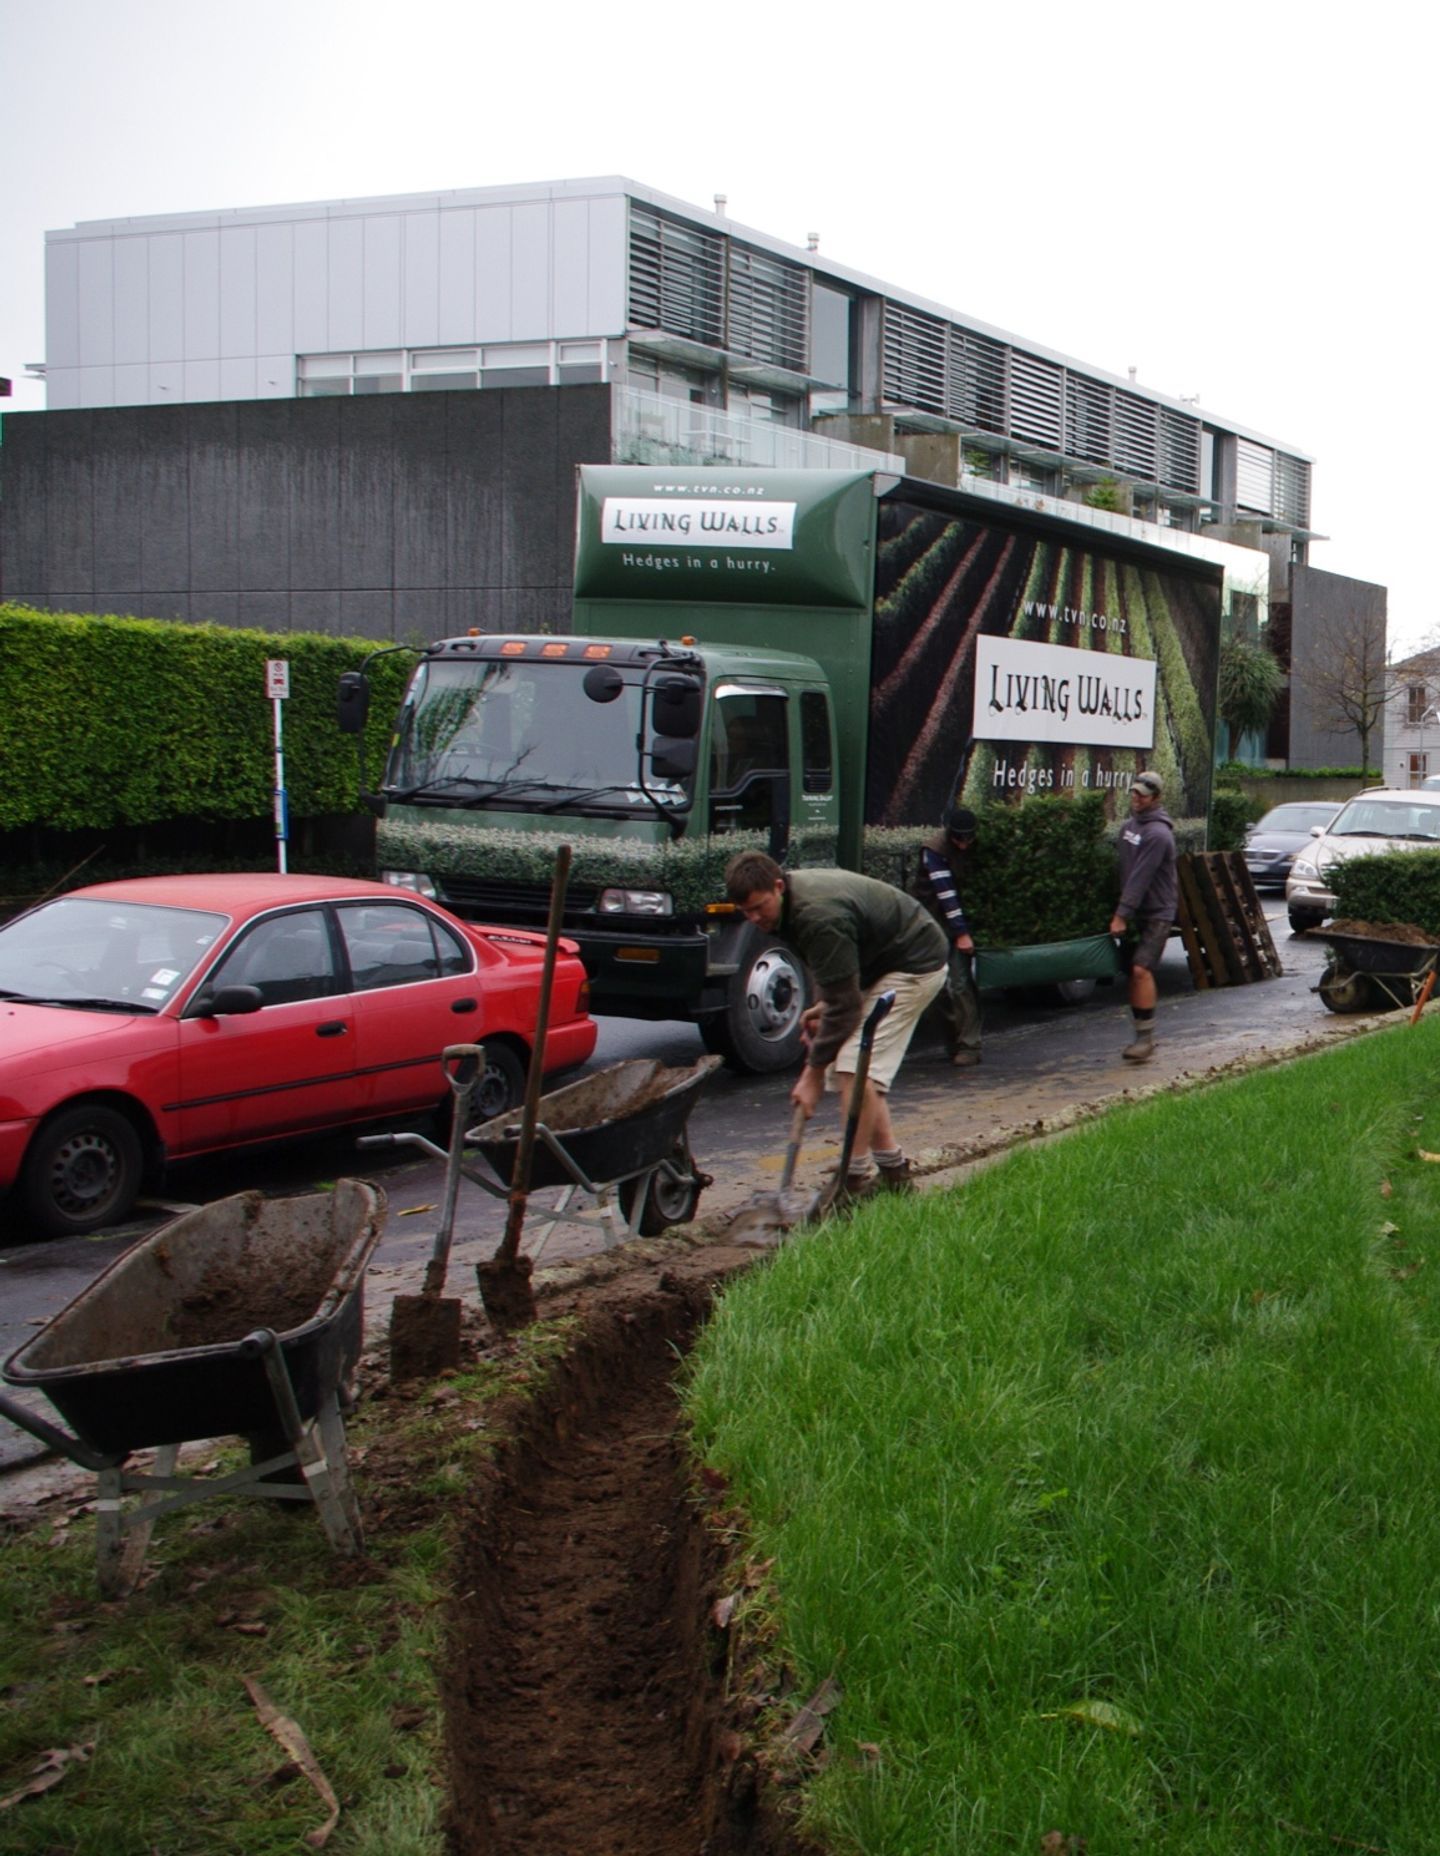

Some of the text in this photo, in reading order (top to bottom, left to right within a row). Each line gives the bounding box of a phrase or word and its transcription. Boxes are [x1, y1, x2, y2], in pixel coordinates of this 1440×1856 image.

[653, 484, 766, 495] www.tvn.co.nz
[614, 509, 777, 536] LIVING WALLS
[623, 553, 776, 573] Hedges in a hurry.
[1023, 601, 1127, 634] www.tvn.co.nz
[988, 664, 1143, 724] LIVING WALLS
[993, 760, 1054, 794] Hedges
[1060, 763, 1075, 787] in
[1081, 771, 1089, 787] a
